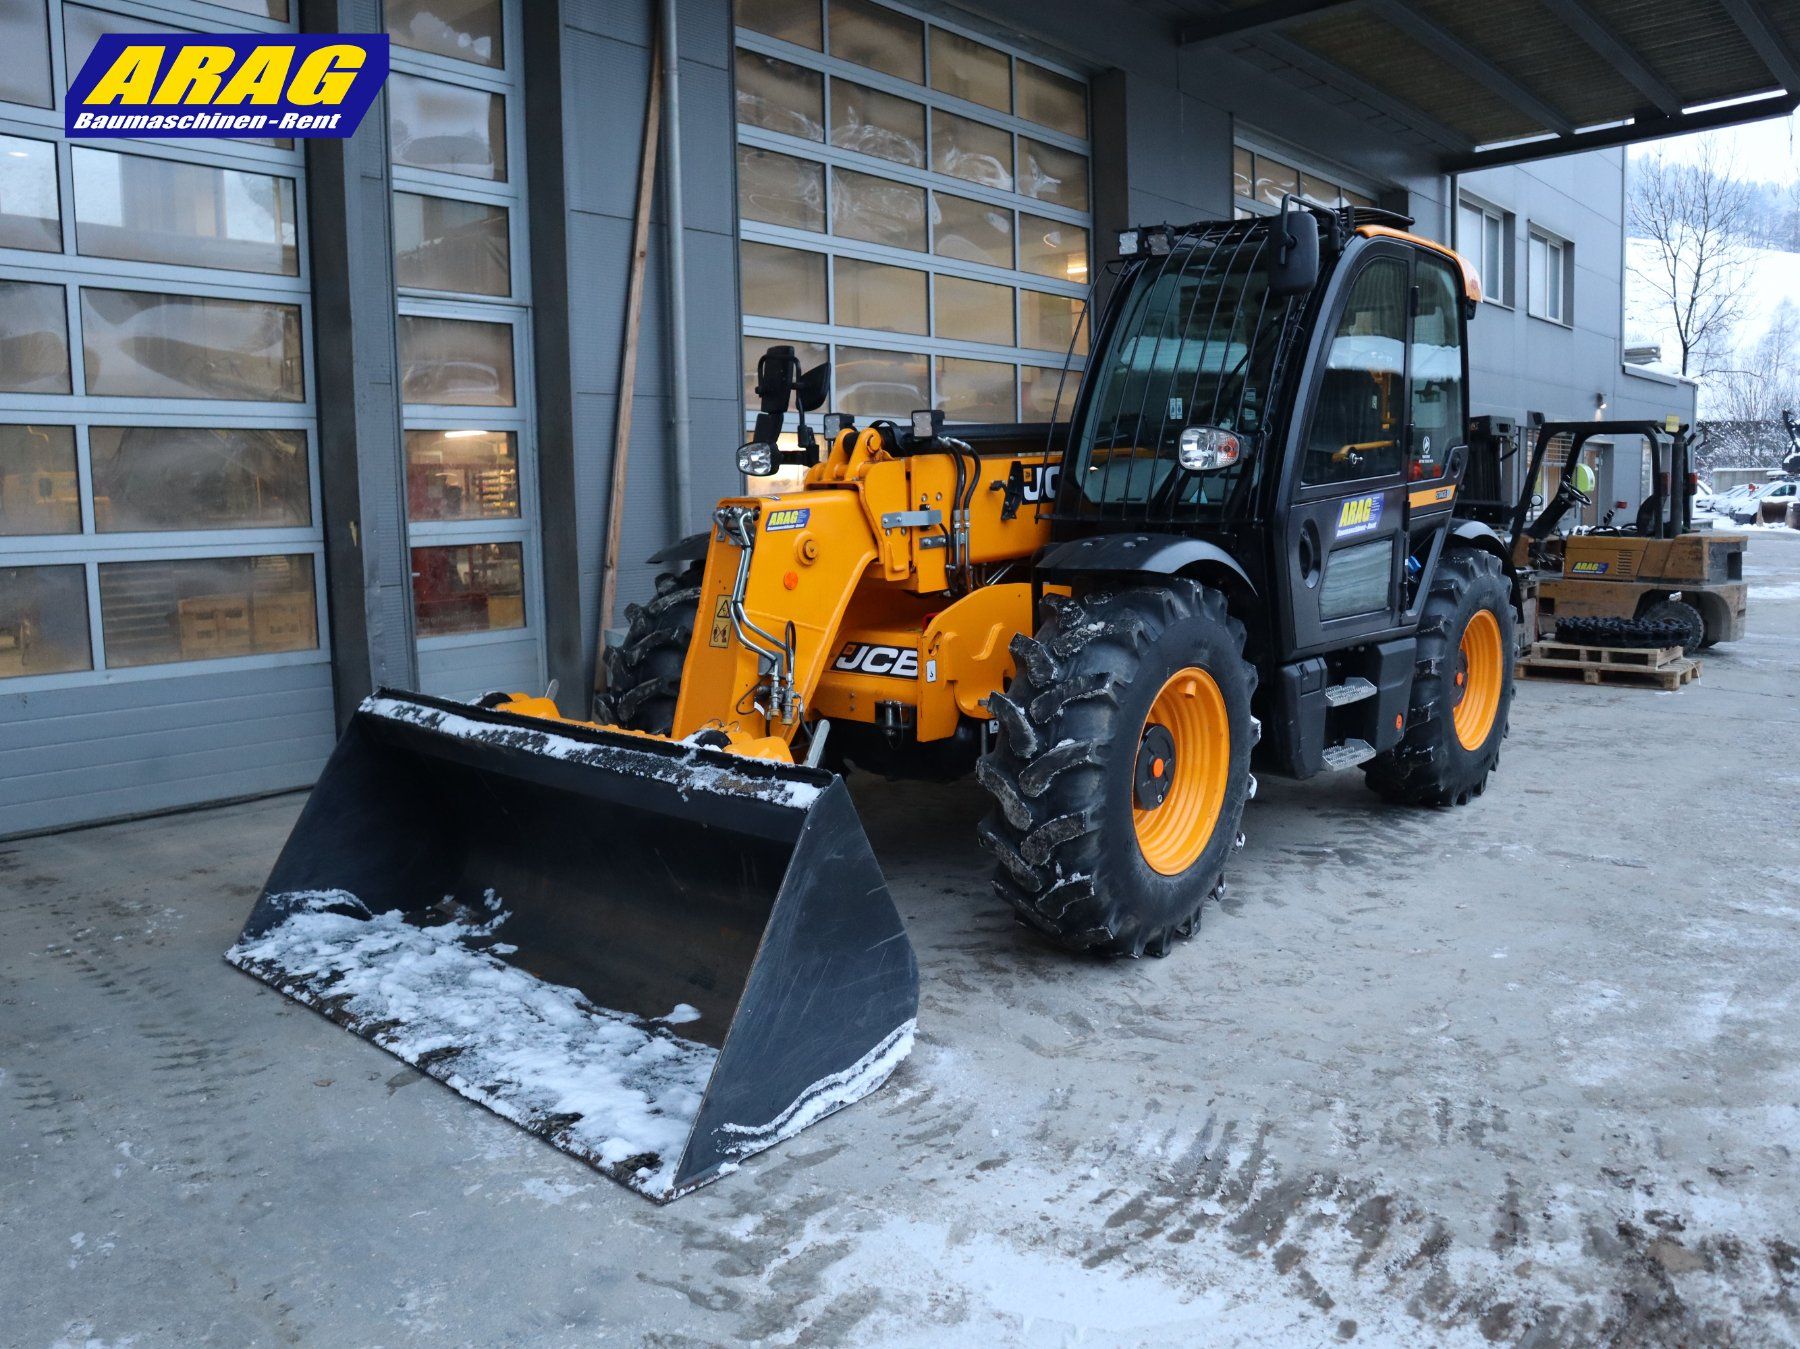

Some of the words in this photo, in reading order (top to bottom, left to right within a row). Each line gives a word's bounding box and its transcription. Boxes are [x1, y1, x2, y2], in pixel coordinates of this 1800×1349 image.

[1023, 465, 1061, 501] JC
[767, 510, 799, 526] ARAG
[1338, 497, 1373, 528] ARAG
[1573, 562, 1599, 571] ARAG
[836, 645, 918, 677] JCB
